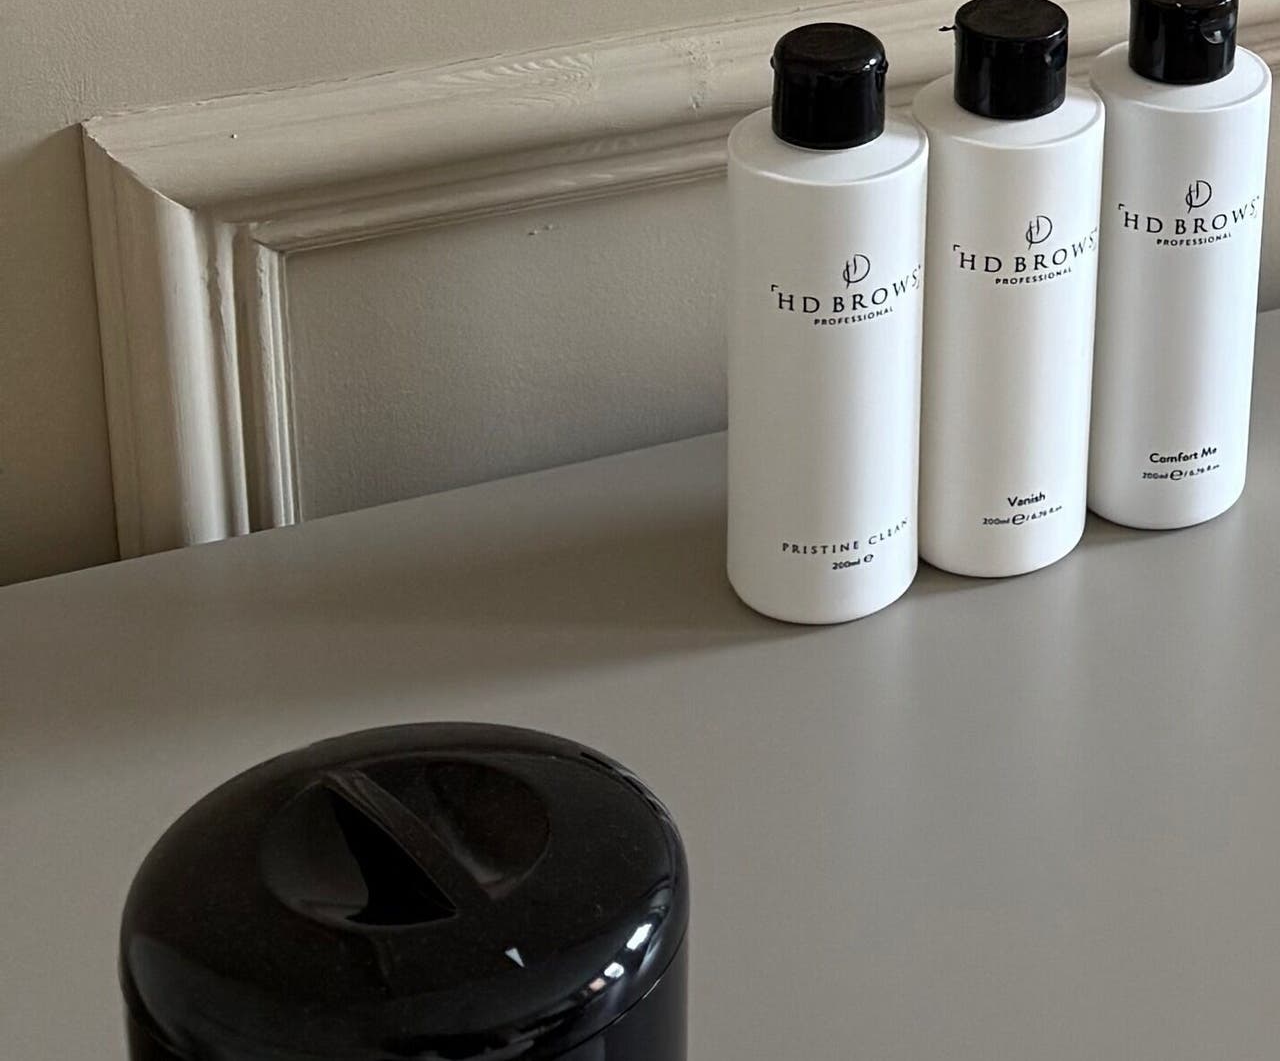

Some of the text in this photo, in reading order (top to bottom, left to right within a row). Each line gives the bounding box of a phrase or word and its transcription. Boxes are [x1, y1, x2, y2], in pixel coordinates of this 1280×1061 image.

[1123, 198, 1258, 235] HD BROWS
[1156, 232, 1232, 247] PROFESSIONAL
[959, 230, 1097, 273] HD BROWS
[995, 266, 1073, 285] PROFESSIONAL
[777, 268, 921, 314] HD BROWS
[813, 306, 894, 326] PROFESSIONAL
[1149, 446, 1217, 464] Comfort Me
[1007, 491, 1046, 507] Vanish
[781, 517, 908, 555] PRISTINE CLEAN
